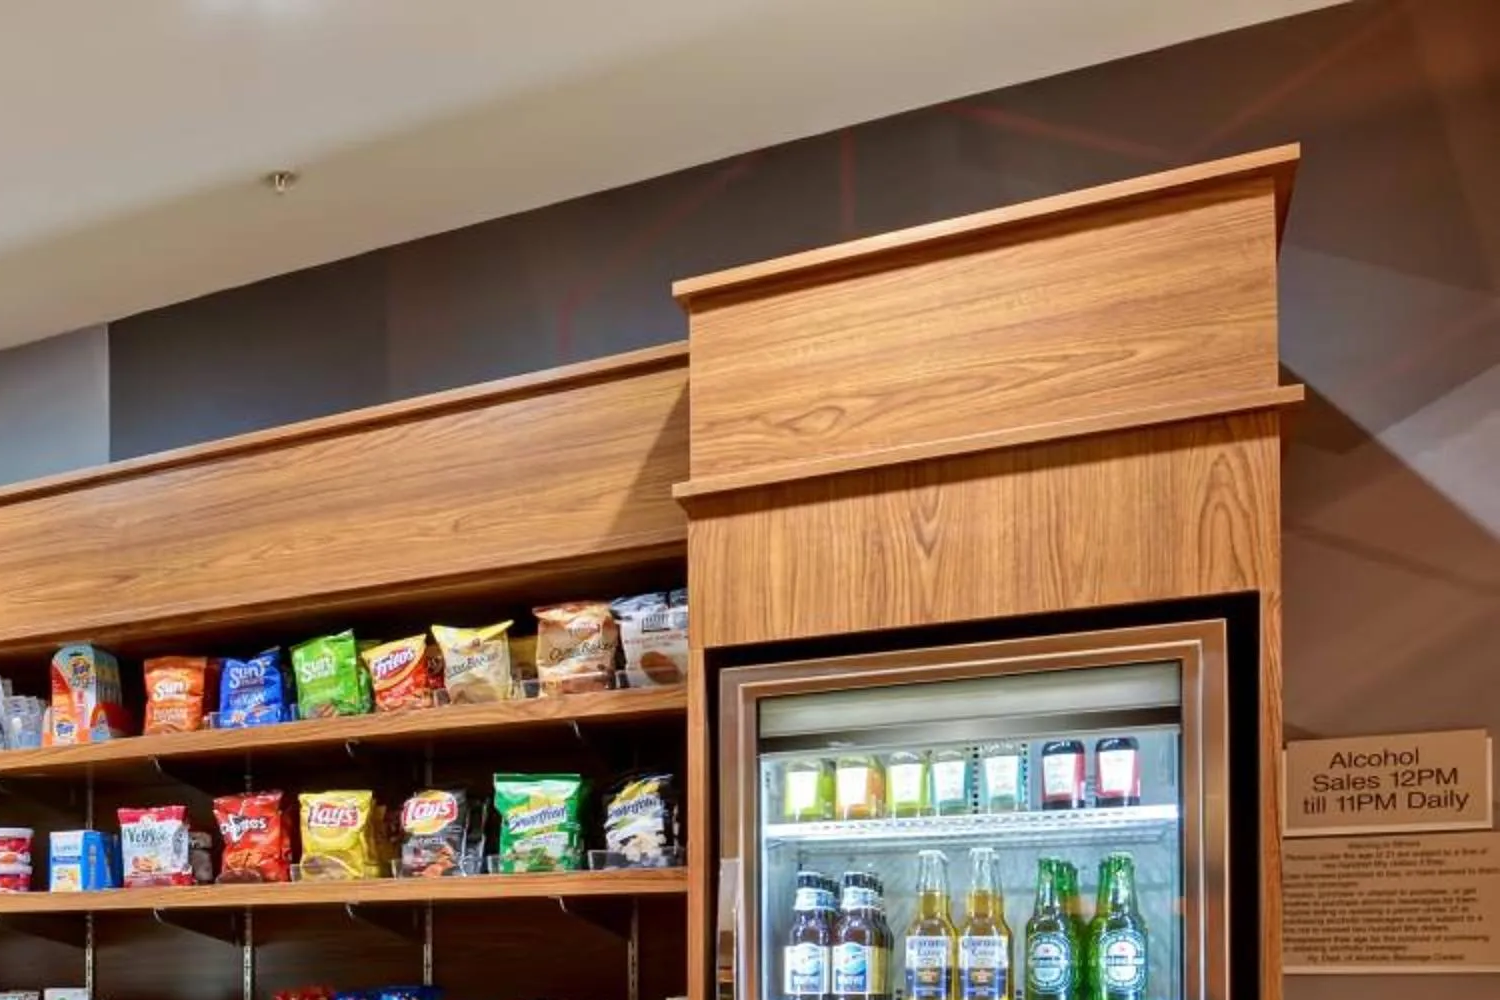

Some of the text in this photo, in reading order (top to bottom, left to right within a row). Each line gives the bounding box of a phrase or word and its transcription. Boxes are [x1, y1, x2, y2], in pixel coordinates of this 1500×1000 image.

[1329, 747, 1419, 769] Alcohol
[1312, 767, 1458, 792] Sales 12PM
[1303, 790, 1470, 814] till 11PM Daily
